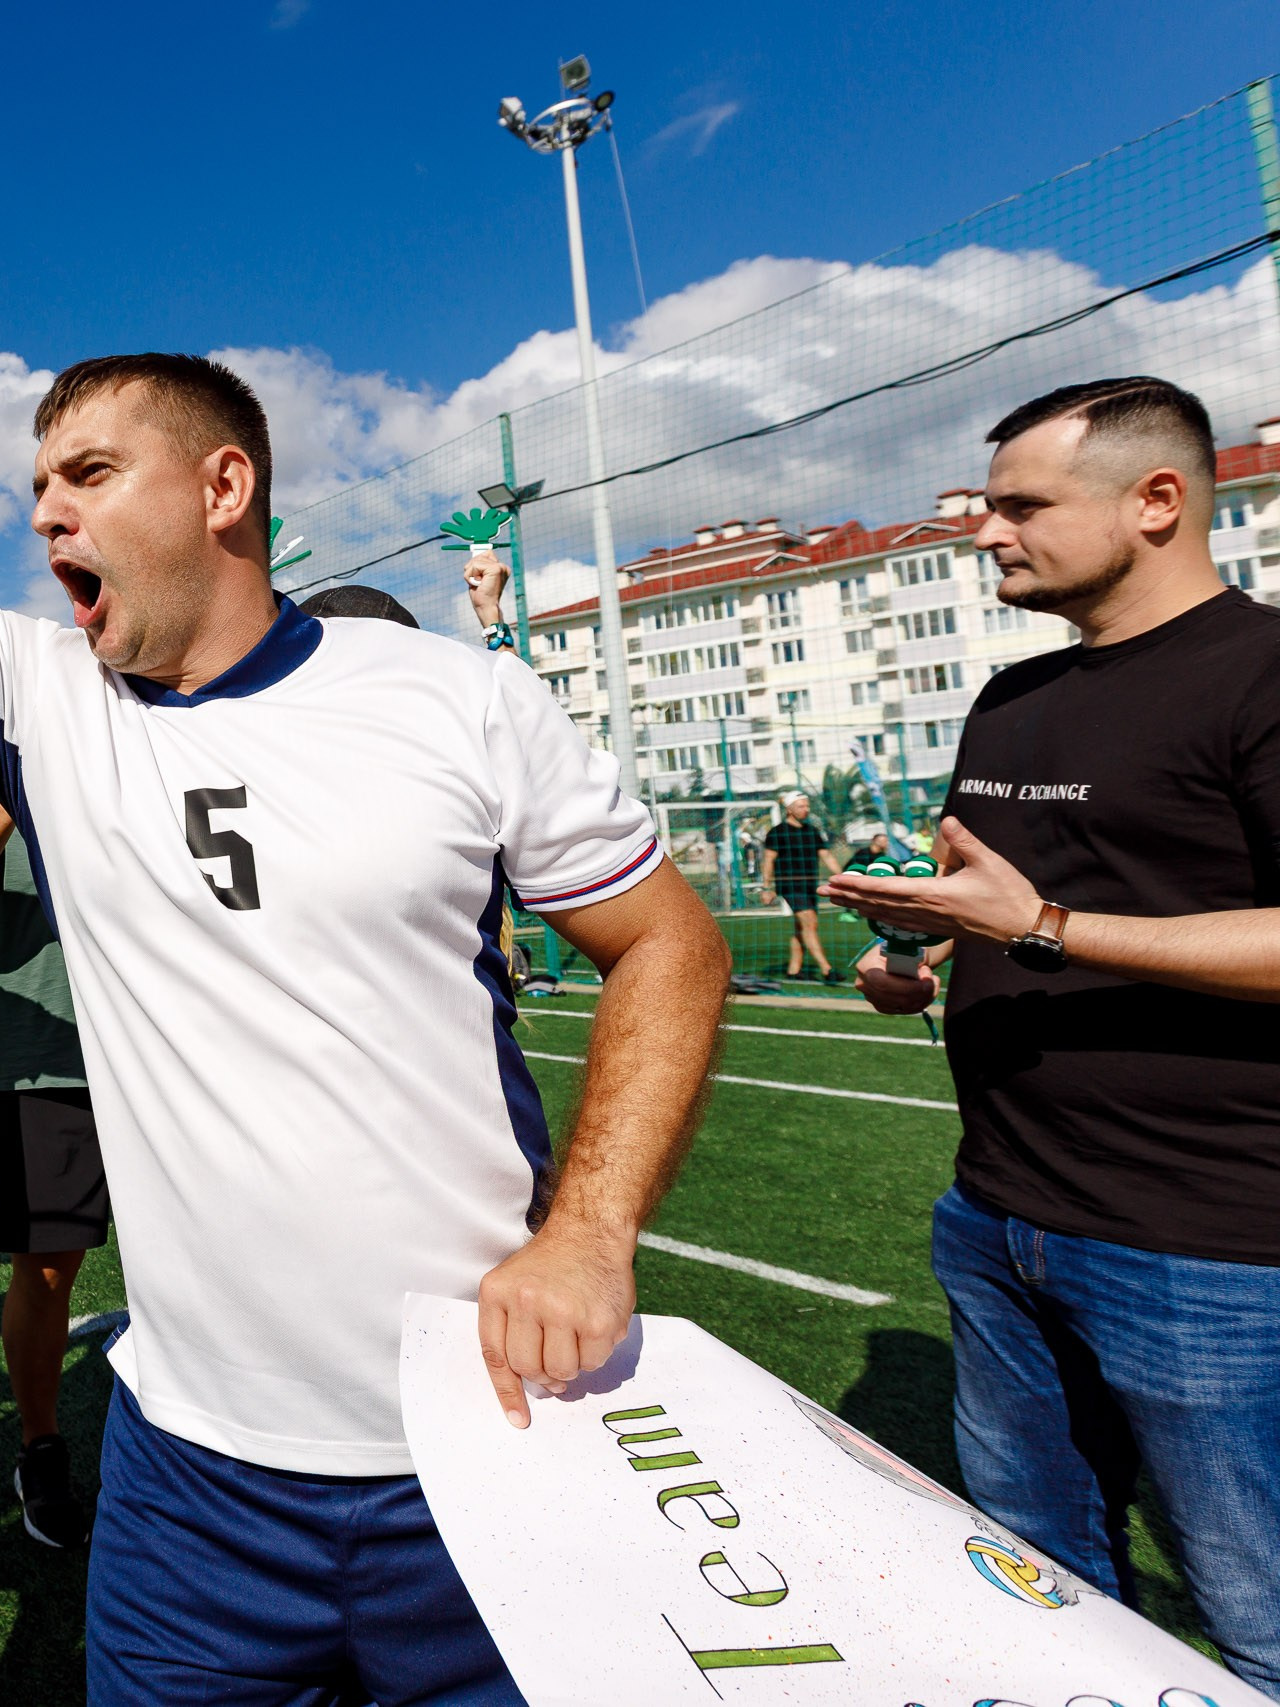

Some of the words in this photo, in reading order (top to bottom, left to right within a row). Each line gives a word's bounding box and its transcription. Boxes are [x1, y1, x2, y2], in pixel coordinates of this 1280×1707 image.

[184, 785, 261, 911] 5
[957, 779, 1013, 798] ARMANI
[1018, 784, 1092, 800] EXCHANGE
[602, 1404, 845, 1701] Team
